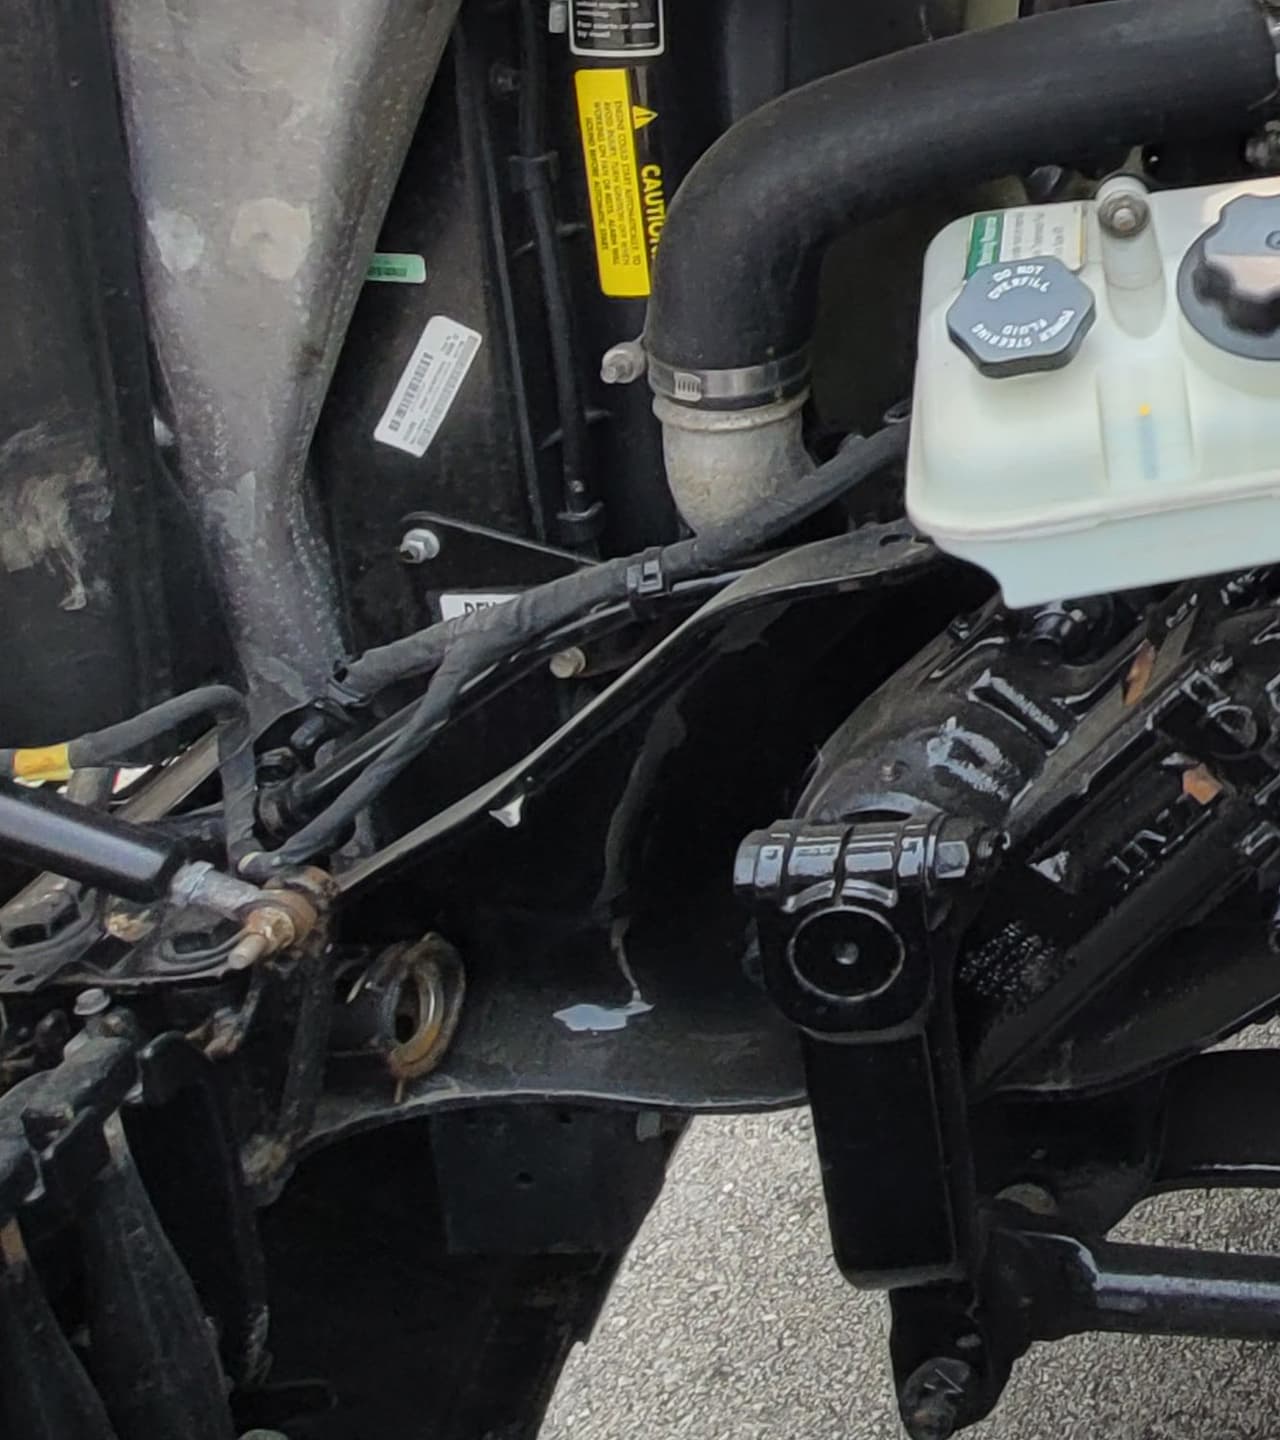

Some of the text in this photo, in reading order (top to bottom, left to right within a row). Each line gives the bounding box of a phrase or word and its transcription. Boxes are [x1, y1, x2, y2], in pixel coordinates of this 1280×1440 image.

[992, 264, 1045, 283] DO NOT
[987, 275, 1051, 300] OVERFILL
[971, 309, 1075, 349] POWER STEERING
[1002, 318, 1047, 336] FLUID
